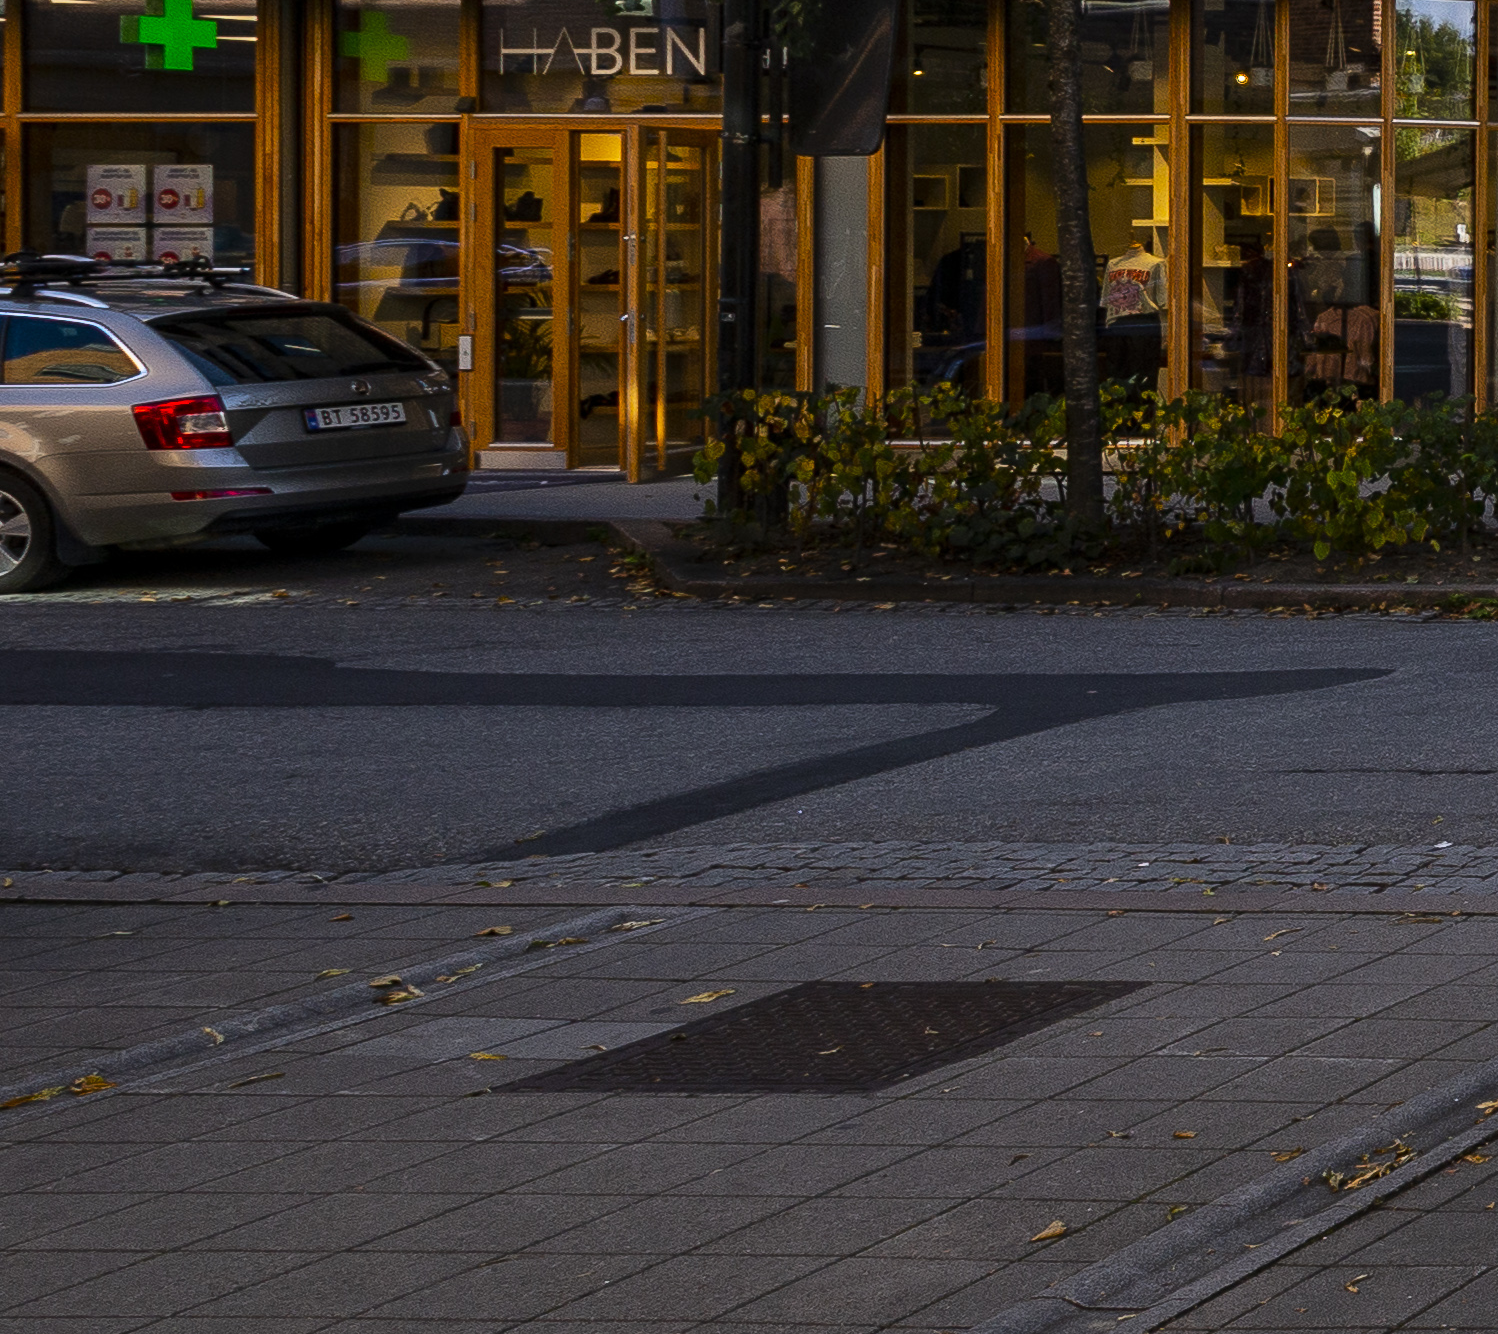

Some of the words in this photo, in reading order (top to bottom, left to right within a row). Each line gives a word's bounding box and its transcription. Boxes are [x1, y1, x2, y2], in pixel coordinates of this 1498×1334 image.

[499, 26, 706, 76] HABEN
[320, 408, 342, 426] BT
[349, 404, 401, 424] 58595
